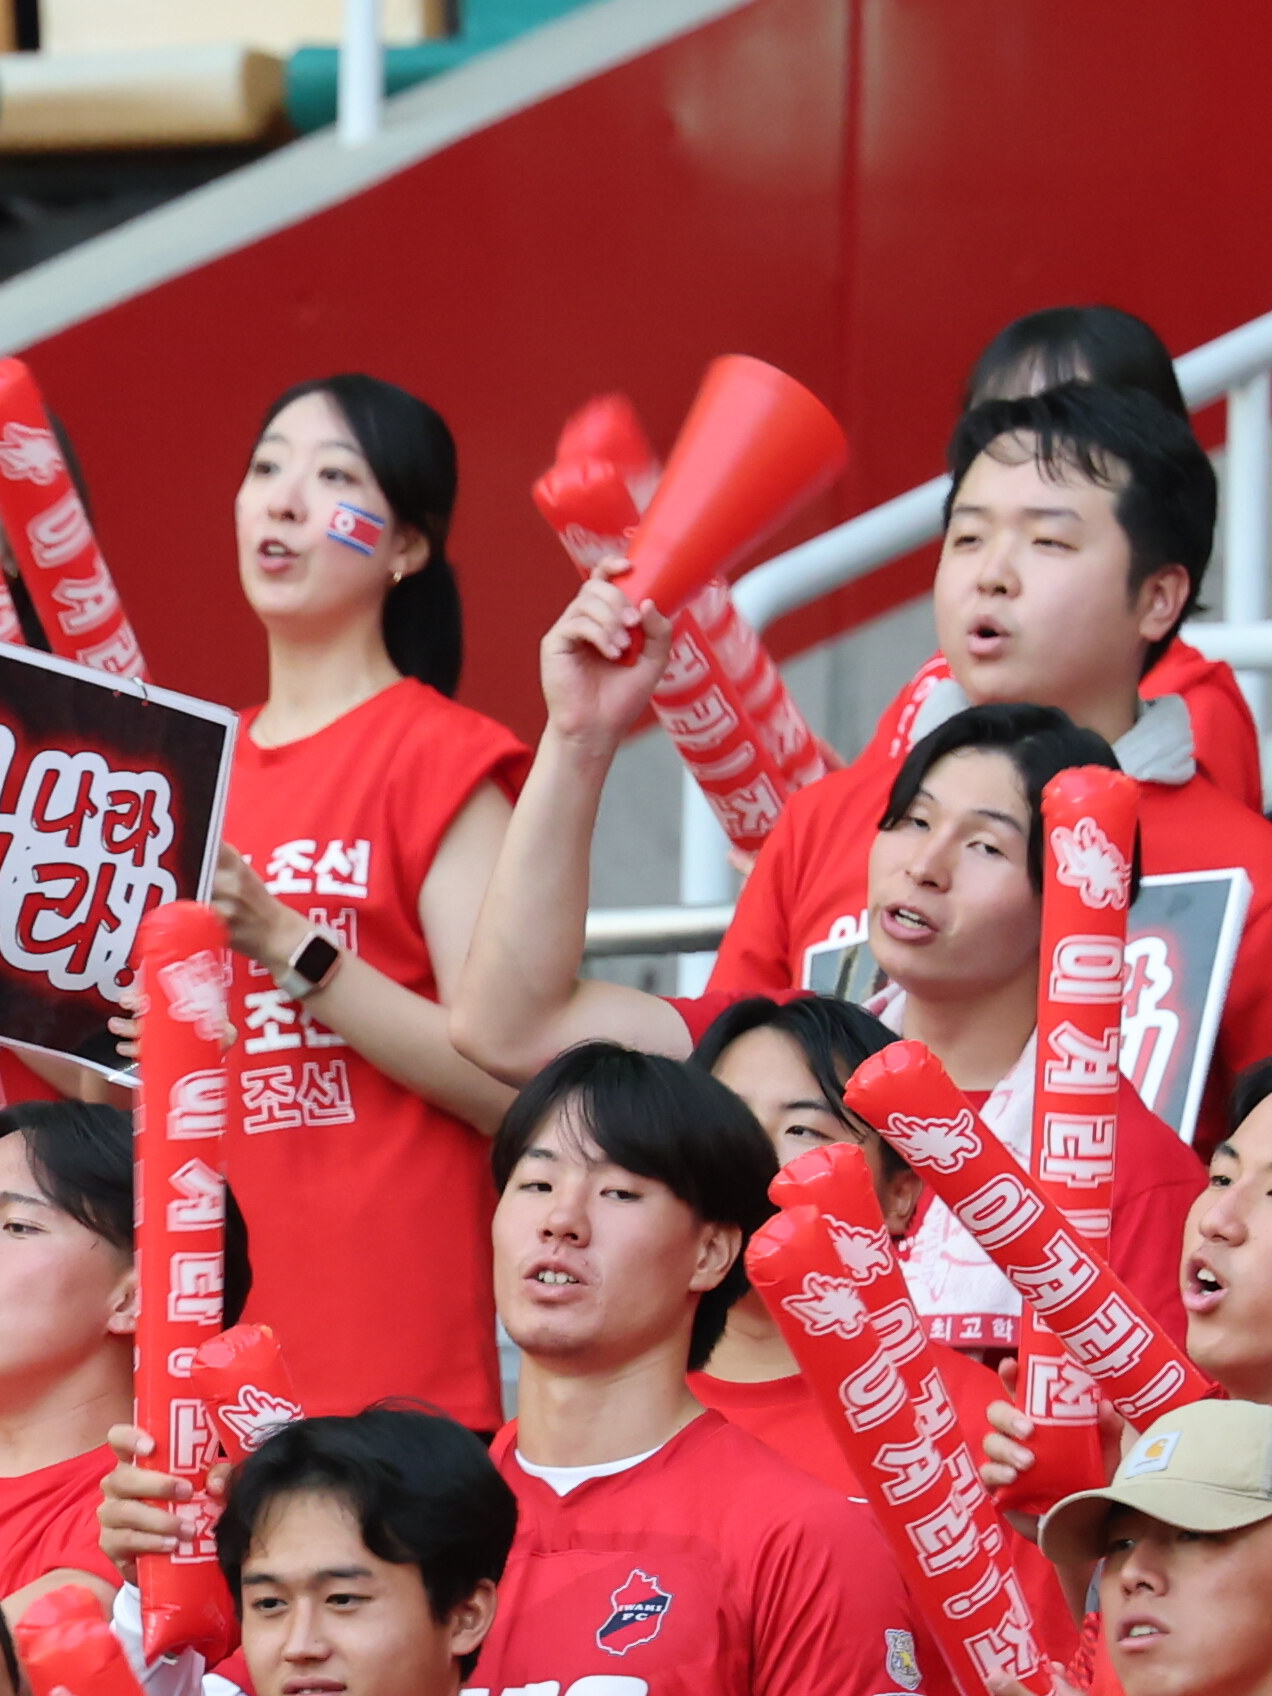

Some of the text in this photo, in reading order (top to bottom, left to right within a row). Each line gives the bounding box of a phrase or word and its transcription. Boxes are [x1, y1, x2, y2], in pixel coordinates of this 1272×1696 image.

[262, 837, 372, 900] 조선
[240, 1058, 357, 1136] 조선
[955, 1170, 1187, 1421] 이겨라!
[839, 1345, 1002, 1622] 이겨라!
